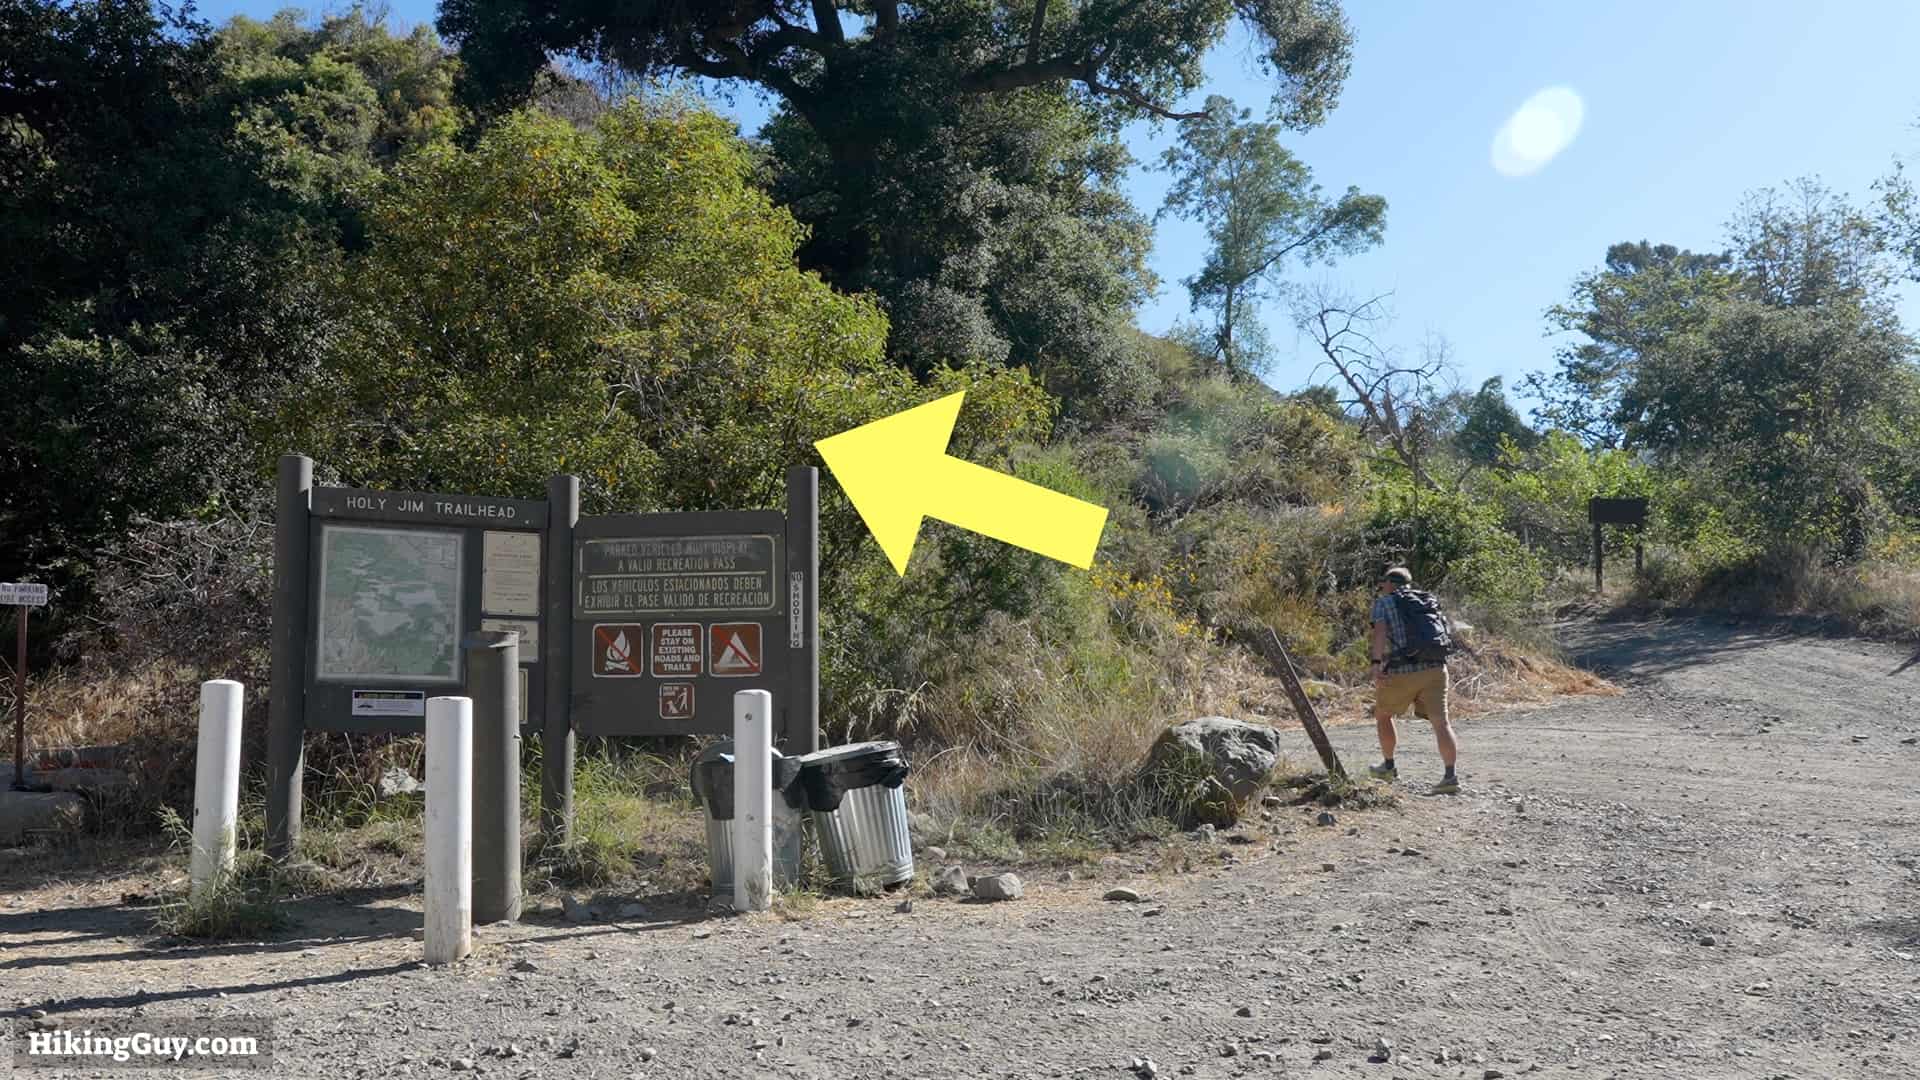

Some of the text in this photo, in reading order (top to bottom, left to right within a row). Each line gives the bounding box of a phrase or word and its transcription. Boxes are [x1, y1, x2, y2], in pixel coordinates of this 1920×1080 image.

[346, 496, 516, 518] HOLY JIM TRAILHEAD
[618, 557, 736, 572] A VALID RECREATION PASS
[592, 576, 762, 593] LOS VEHICULOS ESTACIONADOS DEBEN
[585, 591, 770, 609] EXHIBIR EL PASE VALIDO DE RECREACION
[792, 583, 800, 648] SHOOTING
[662, 628, 693, 637] PLEASE
[660, 637, 694, 646] STAY ON
[658, 646, 696, 654] EXISTING
[655, 655, 700, 663] ROADS AND
[663, 663, 692, 671] TRAILS
